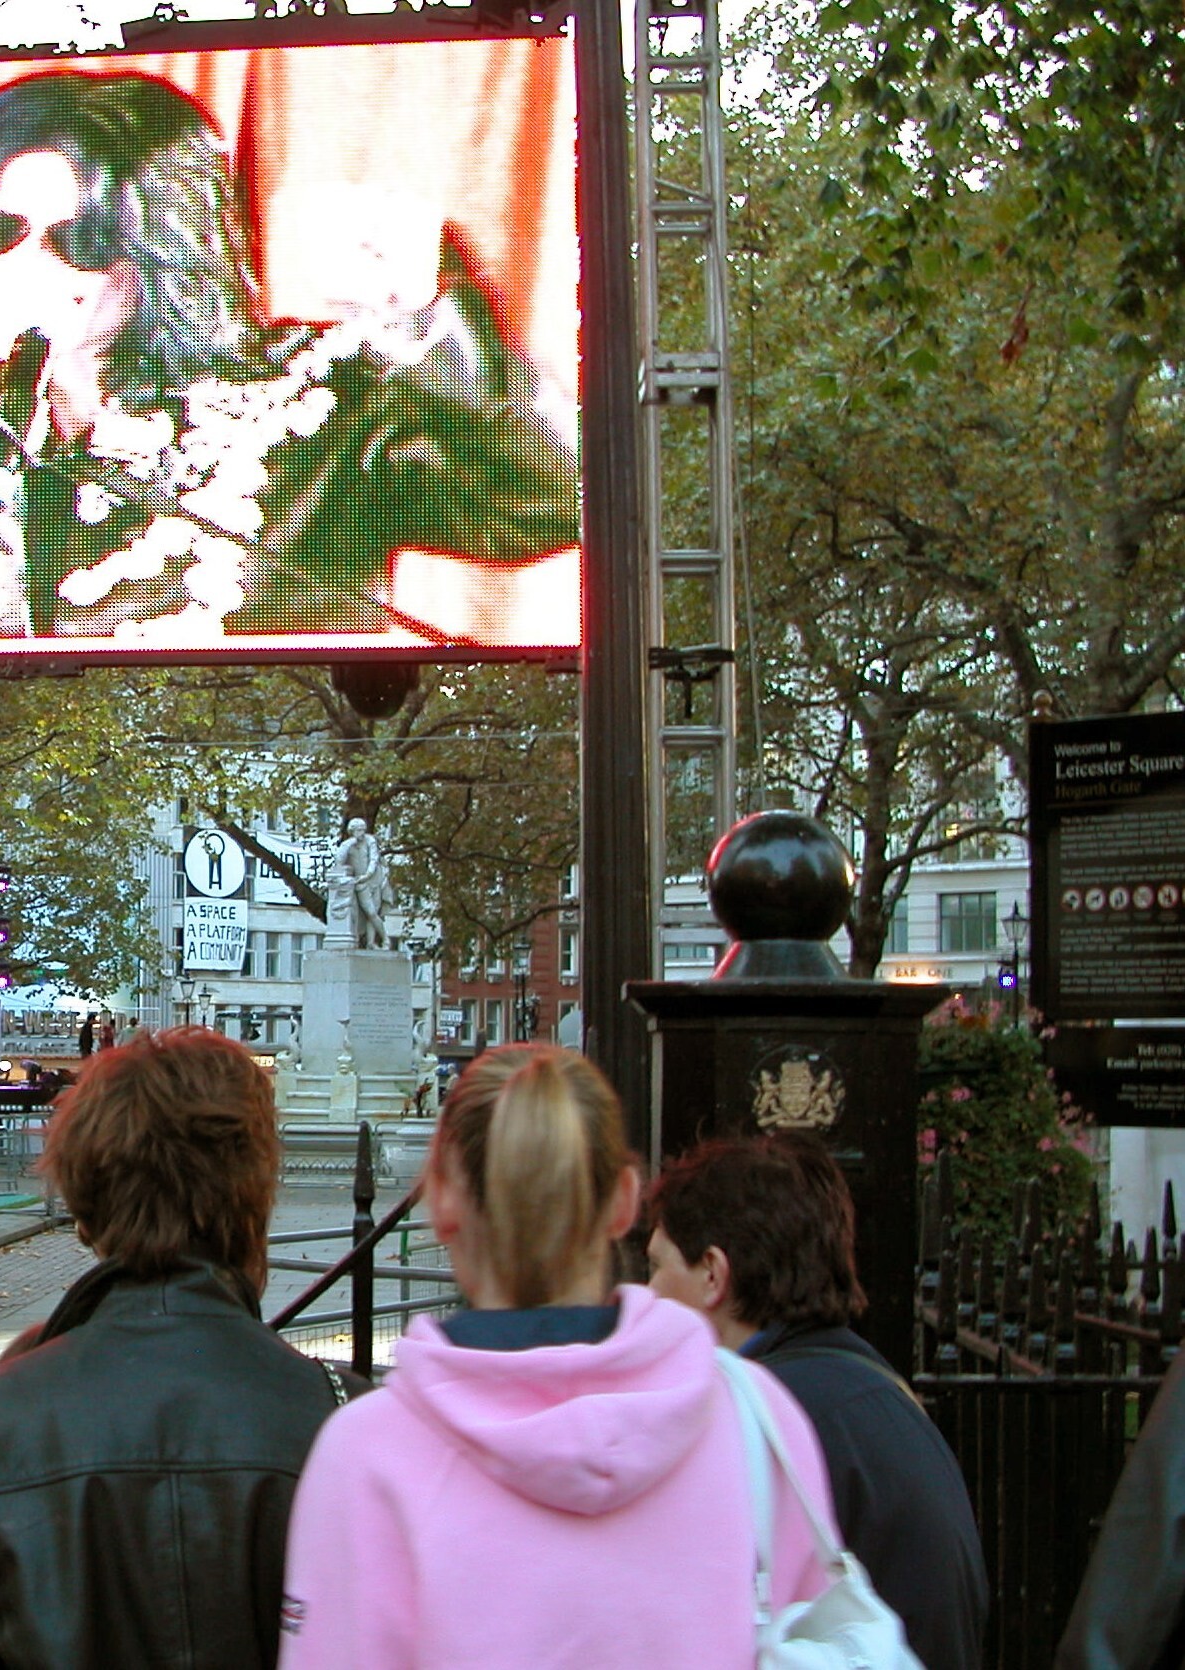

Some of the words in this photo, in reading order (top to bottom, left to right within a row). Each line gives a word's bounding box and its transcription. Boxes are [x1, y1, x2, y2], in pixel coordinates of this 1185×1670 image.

[1054, 742, 1108, 757] Welcome
[1109, 740, 1122, 753] to
[1055, 758, 1126, 779] Leicester
[1128, 753, 1185, 777] Square
[1055, 781, 1107, 799] Hogarth
[1109, 780, 1142, 795] Gate
[186, 904, 197, 918] A
[199, 904, 236, 920] SPACE
[186, 923, 197, 938] A
[199, 923, 246, 942] PLATFORM
[186, 941, 197, 961] A
[200, 941, 244, 962] COMMUNITY
